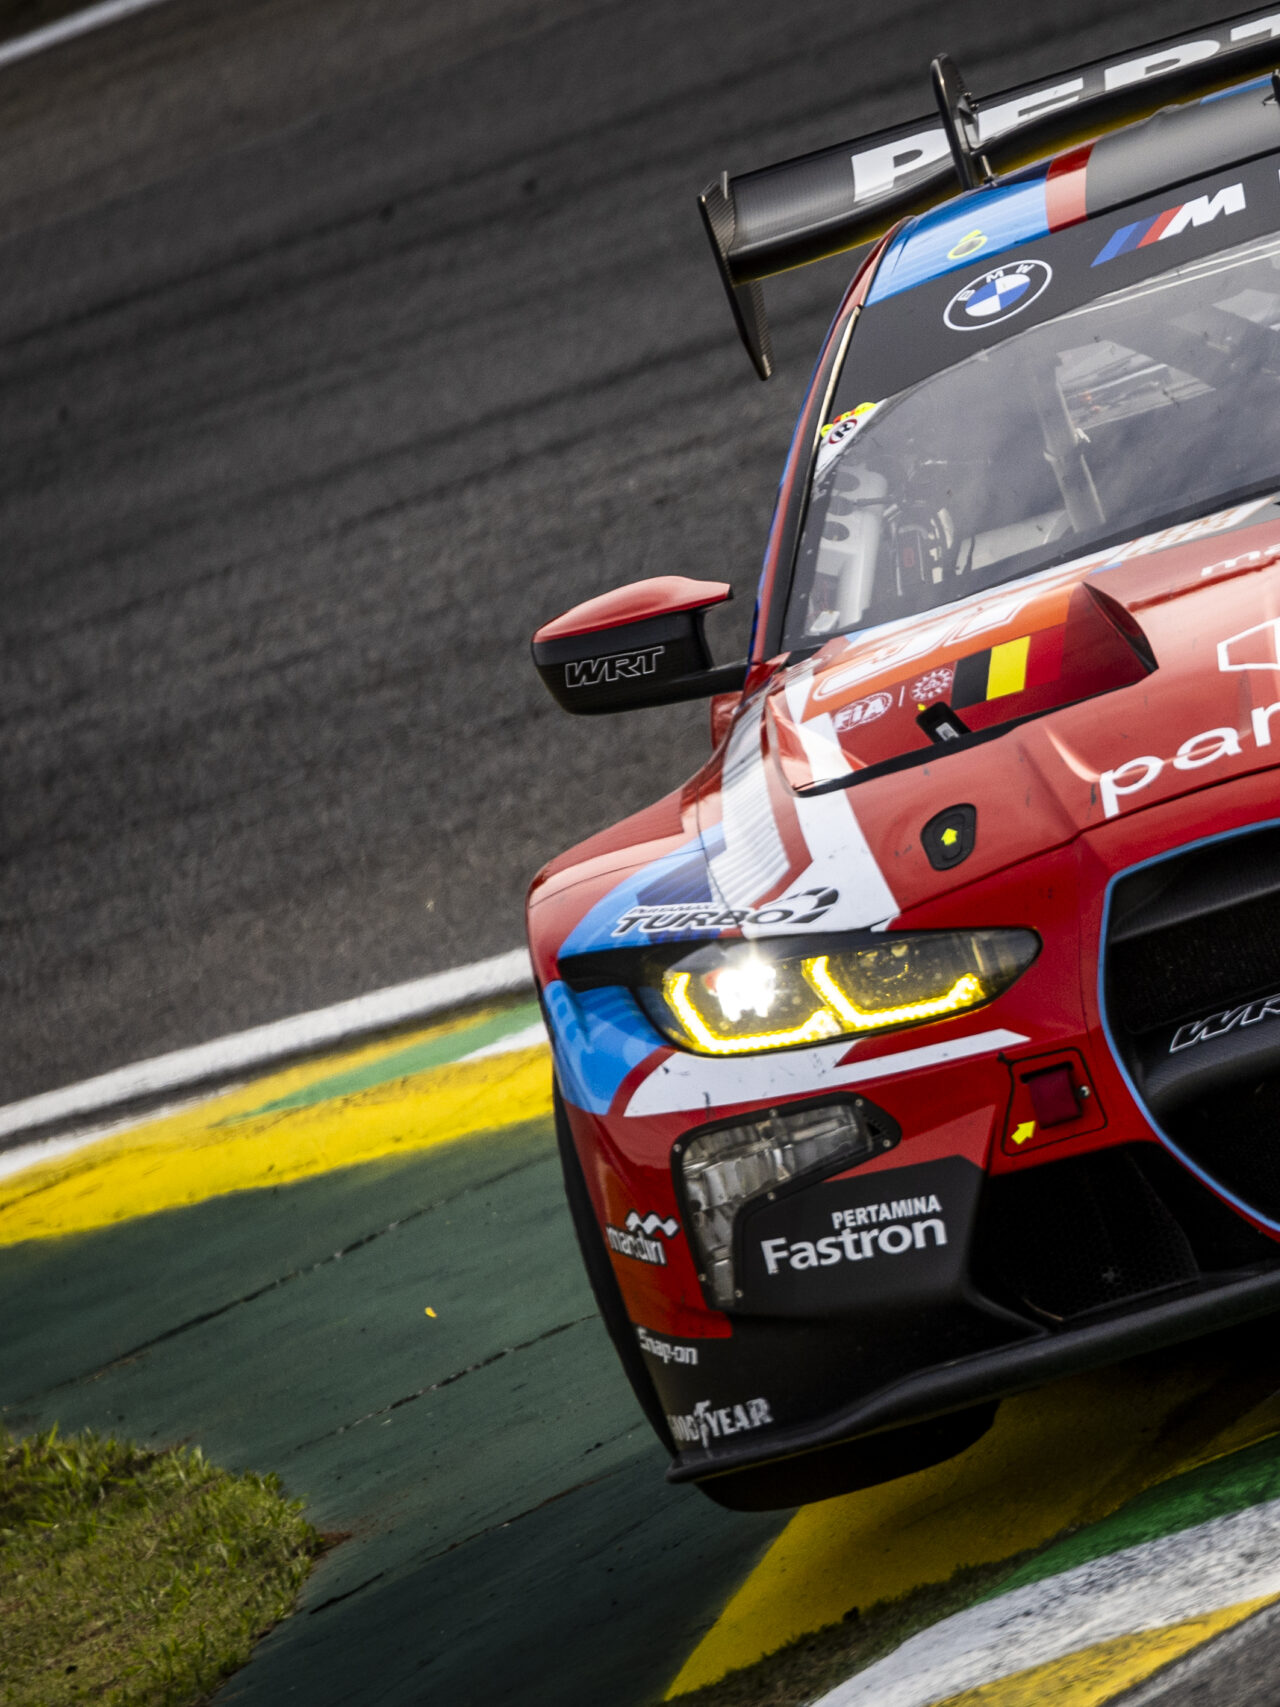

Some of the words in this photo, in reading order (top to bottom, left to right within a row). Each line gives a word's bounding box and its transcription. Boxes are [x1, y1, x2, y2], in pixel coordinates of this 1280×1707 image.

[565, 645, 664, 688] WRT
[832, 1195, 943, 1230] PERTAMINA
[761, 1218, 948, 1275] Fastron
[637, 1326, 698, 1365] Snap-on
